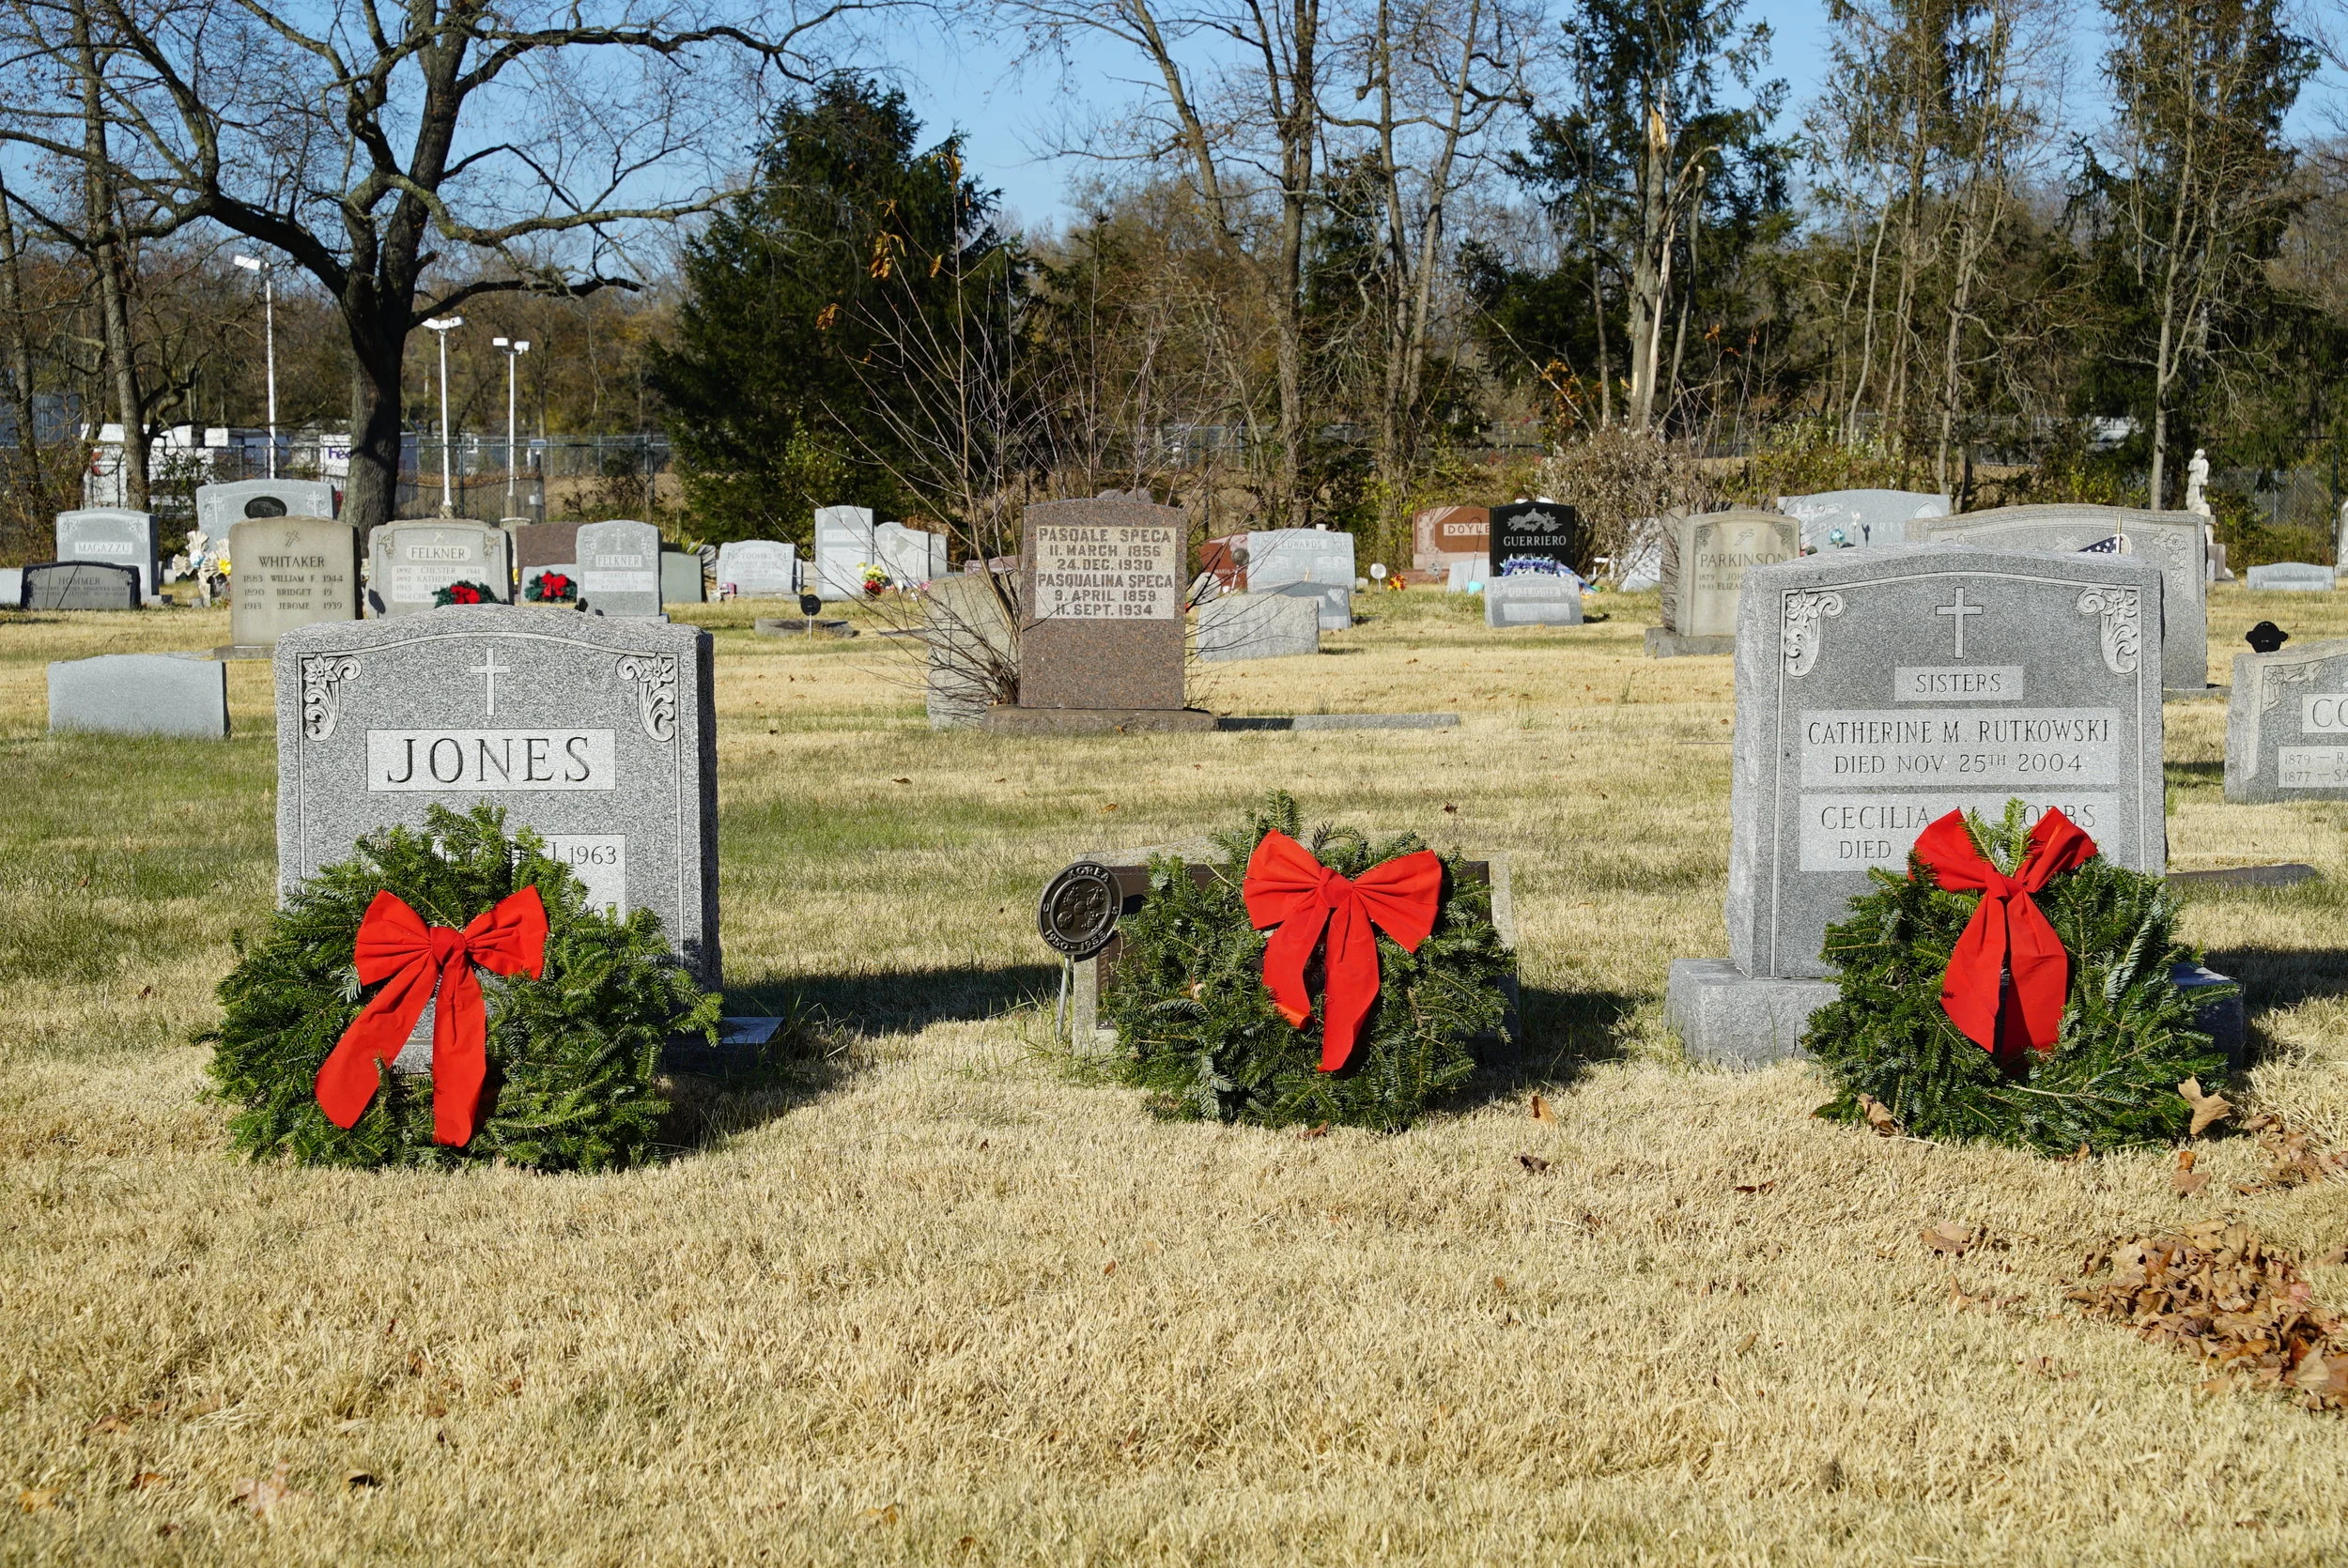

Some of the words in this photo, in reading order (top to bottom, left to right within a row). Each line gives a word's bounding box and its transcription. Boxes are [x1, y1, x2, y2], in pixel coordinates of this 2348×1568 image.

[1039, 528, 1108, 543] PASQALE
[1120, 529, 1171, 543] SPECA
[1448, 525, 1490, 534] DOYLE
[1281, 540, 1322, 549] EDWARDS
[1503, 535, 1567, 546] GUERRIERO
[78, 543, 130, 553] MAGAZZU
[411, 547, 466, 560] FELKNER
[1066, 545, 1118, 557] MARCH
[1128, 545, 1161, 557] 1856
[258, 556, 325, 568] WHITAKER
[597, 556, 640, 565] FELKNER
[1119, 560, 1153, 571] 1930
[1700, 553, 1787, 567] PARKINSON
[421, 566, 456, 575] CHESTER
[58, 576, 100, 586] HOMMER
[1037, 574, 1123, 589] PASQUALINA
[1128, 575, 1174, 589] SPECA
[1726, 573, 1744, 581] JOH
[1071, 590, 1116, 602] APRIL
[1123, 590, 1157, 602] 1859
[278, 602, 310, 610] JEROME
[1073, 605, 1114, 616] SEPT.
[1119, 605, 1153, 616] 1934
[1915, 673, 2001, 693] SISTERS
[1807, 721, 1932, 746] CATHERINE
[1978, 719, 2109, 743] RUTKOWSKI
[387, 736, 591, 784] JONES
[1834, 755, 1886, 774] DIED
[1897, 755, 1945, 774] NOV
[2018, 753, 2082, 772] 2004
[2284, 754, 2310, 765] 1879
[2284, 772, 2311, 782] 1877
[1821, 806, 1930, 830] CECILIA
[569, 845, 616, 865] 1963
[1839, 840, 1892, 859] DIED
[1067, 866, 1110, 883] KOREA
[1043, 903, 1050, 913] U
[1111, 905, 1119, 915] S
